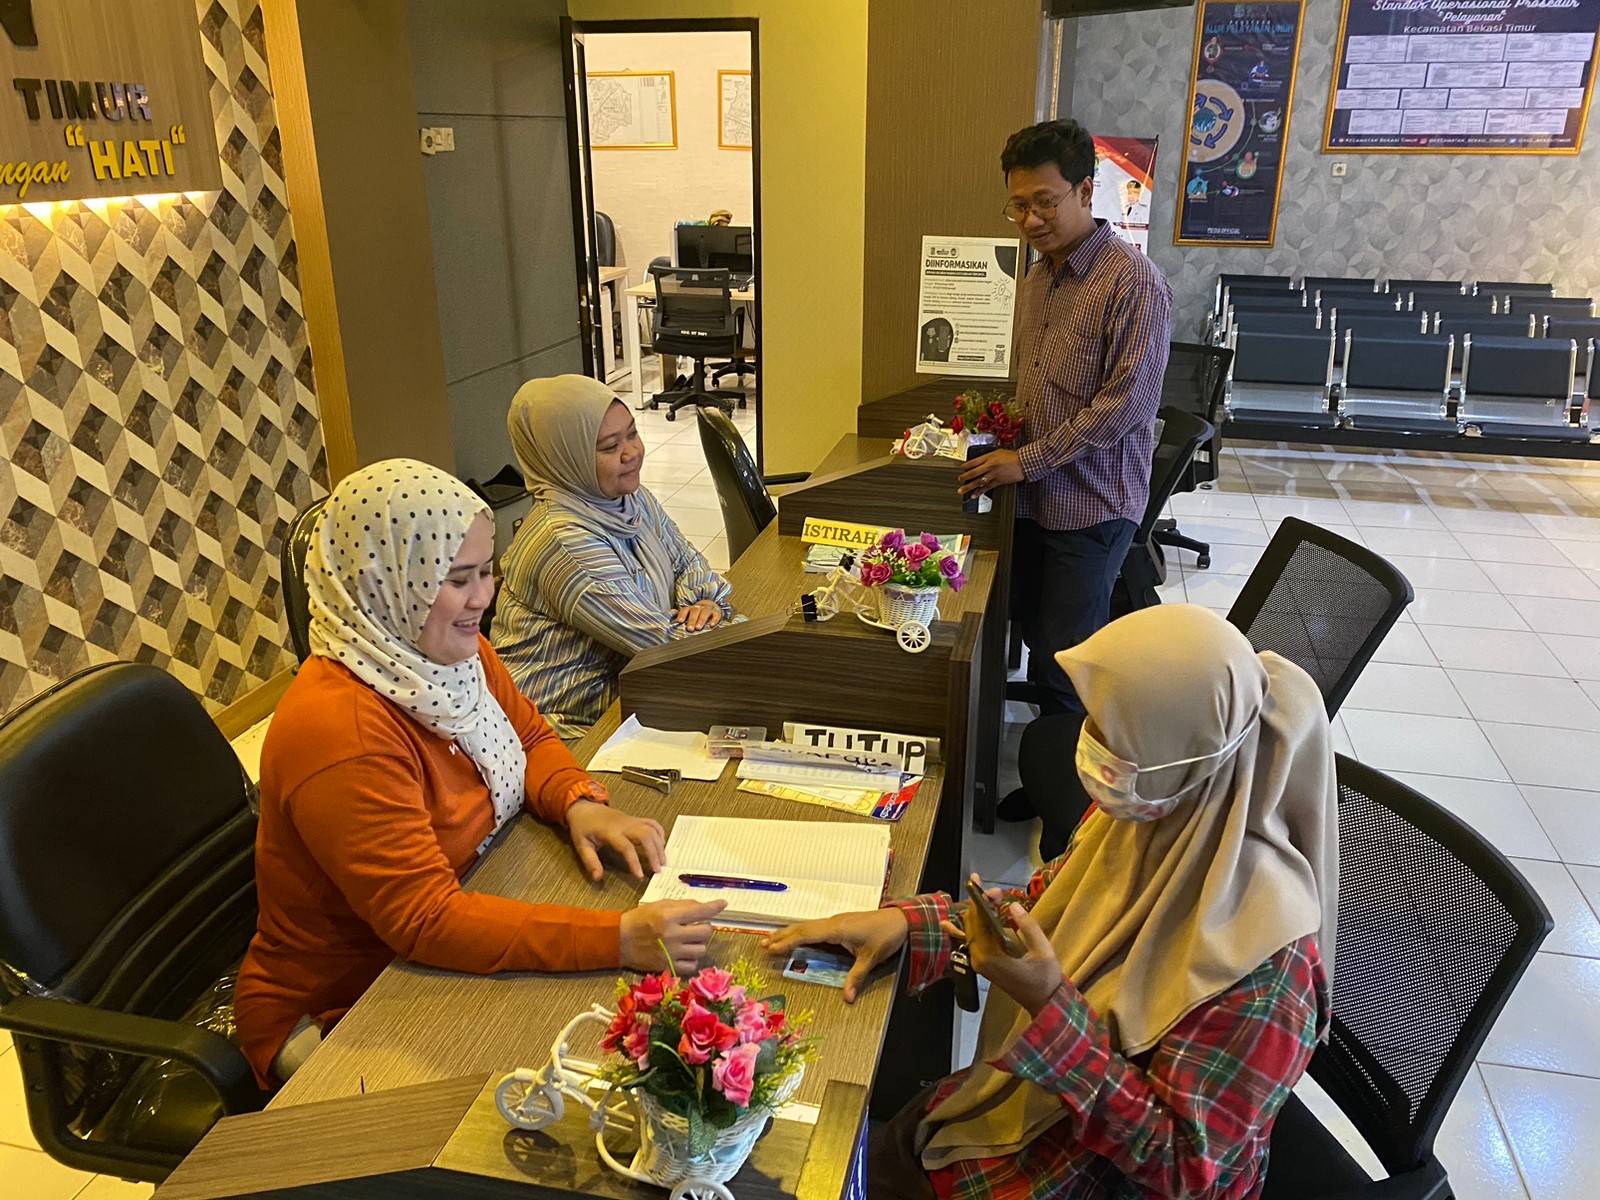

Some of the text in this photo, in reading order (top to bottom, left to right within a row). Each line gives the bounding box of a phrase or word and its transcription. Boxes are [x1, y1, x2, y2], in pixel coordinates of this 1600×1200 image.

[1403, 24, 1537, 34] Kecamatan Bekasi Timur
[13, 78, 152, 121] TIMUR
[925, 259, 988, 270] DIINFORMASIKAN
[803, 523, 881, 545] ISTIRAH
